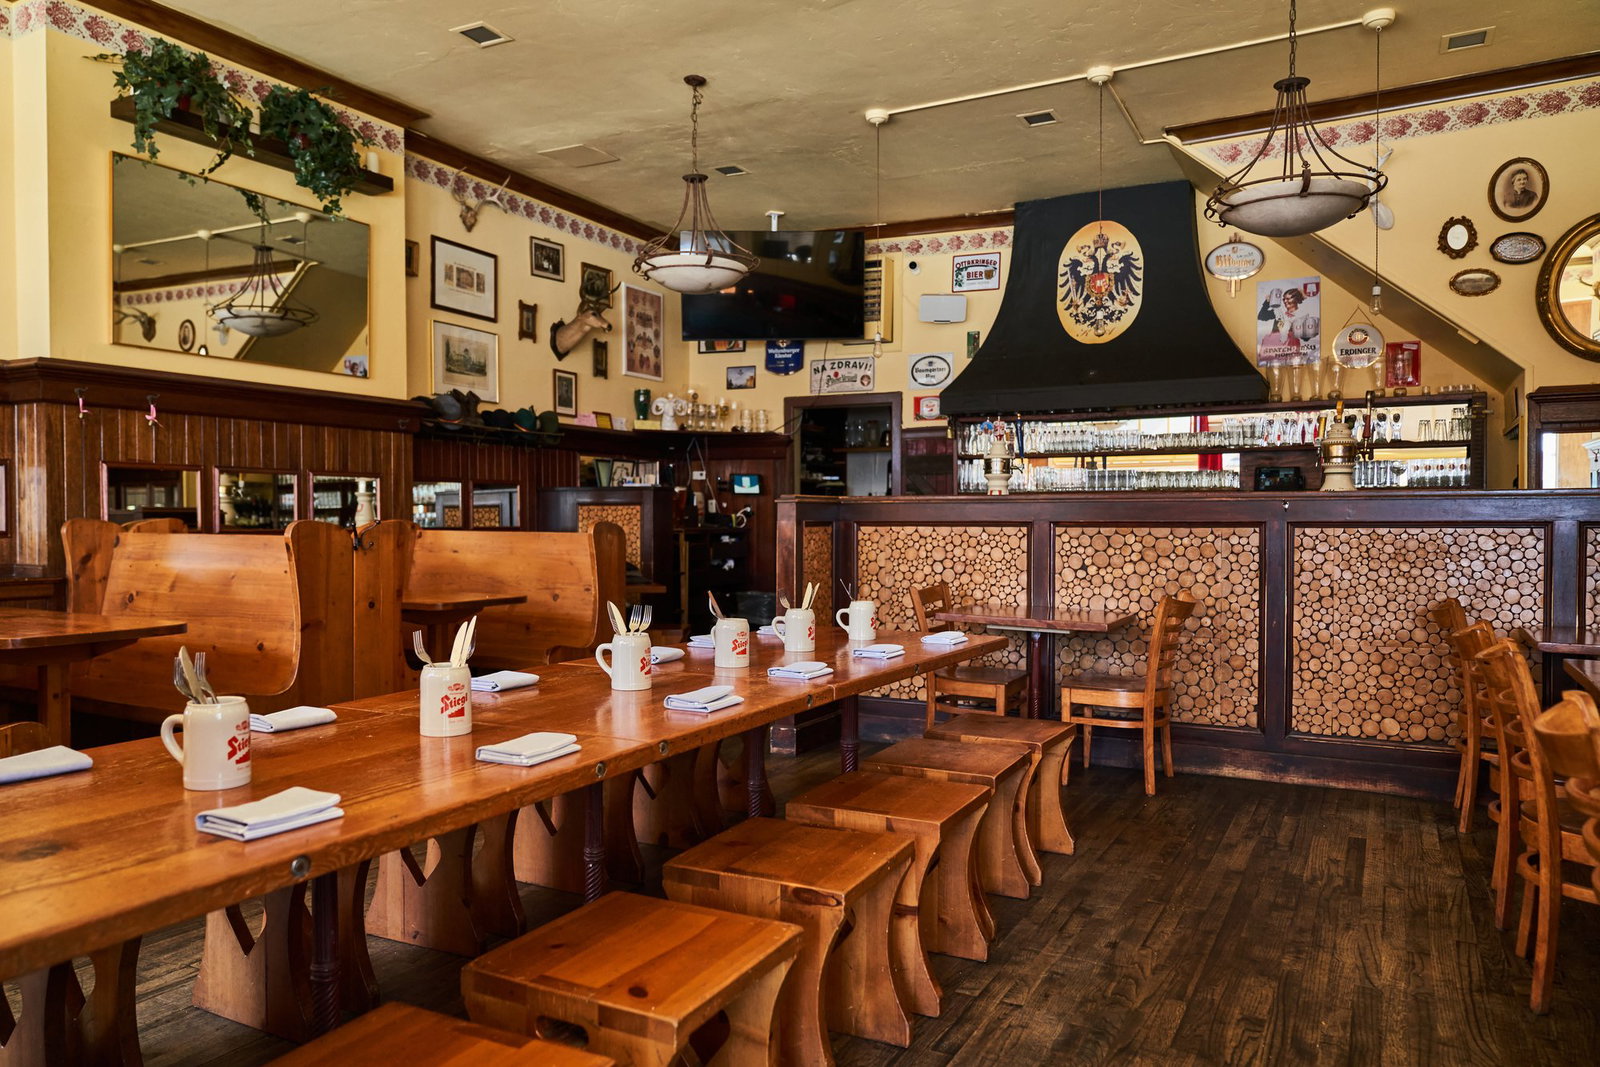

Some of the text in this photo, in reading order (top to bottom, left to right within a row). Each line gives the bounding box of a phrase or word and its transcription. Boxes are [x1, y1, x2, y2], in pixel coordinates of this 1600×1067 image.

[955, 259, 998, 270] OTTAKRINGER
[966, 270, 984, 279] BIER
[1340, 347, 1377, 356] ERDINGER
[813, 364, 827, 375] NA
[440, 692, 468, 714] Stiegl
[227, 735, 250, 761] Stie
